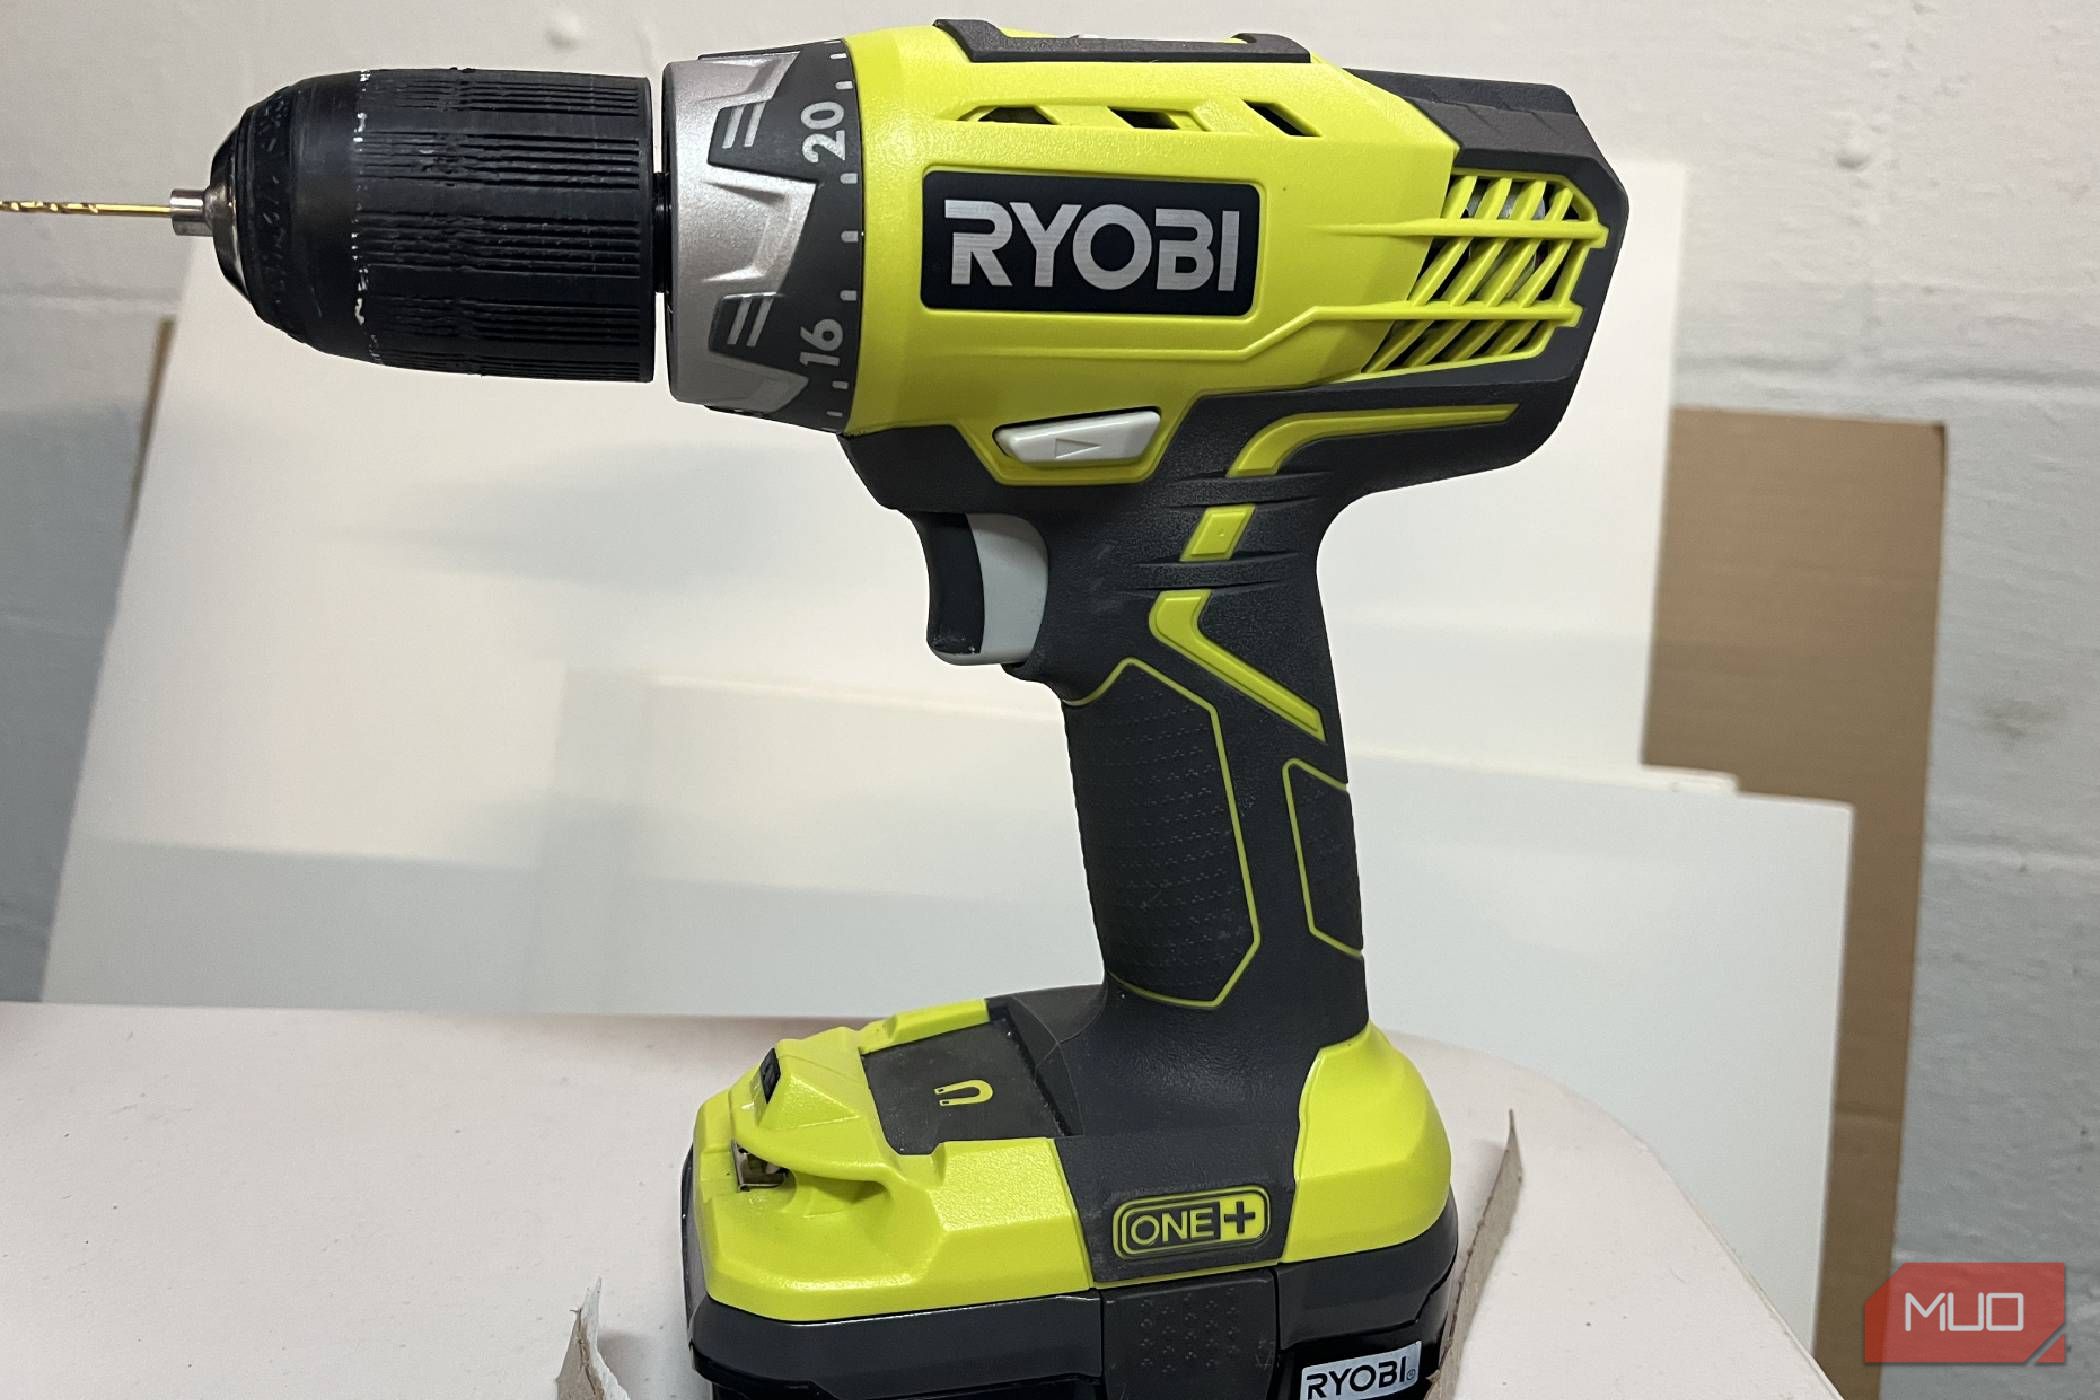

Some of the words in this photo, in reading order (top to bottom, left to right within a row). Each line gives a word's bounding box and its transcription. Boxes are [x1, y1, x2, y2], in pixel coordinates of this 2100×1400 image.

[800, 101, 845, 161] 20
[945, 199, 1240, 291] RYOBI
[800, 318, 844, 366] 16
